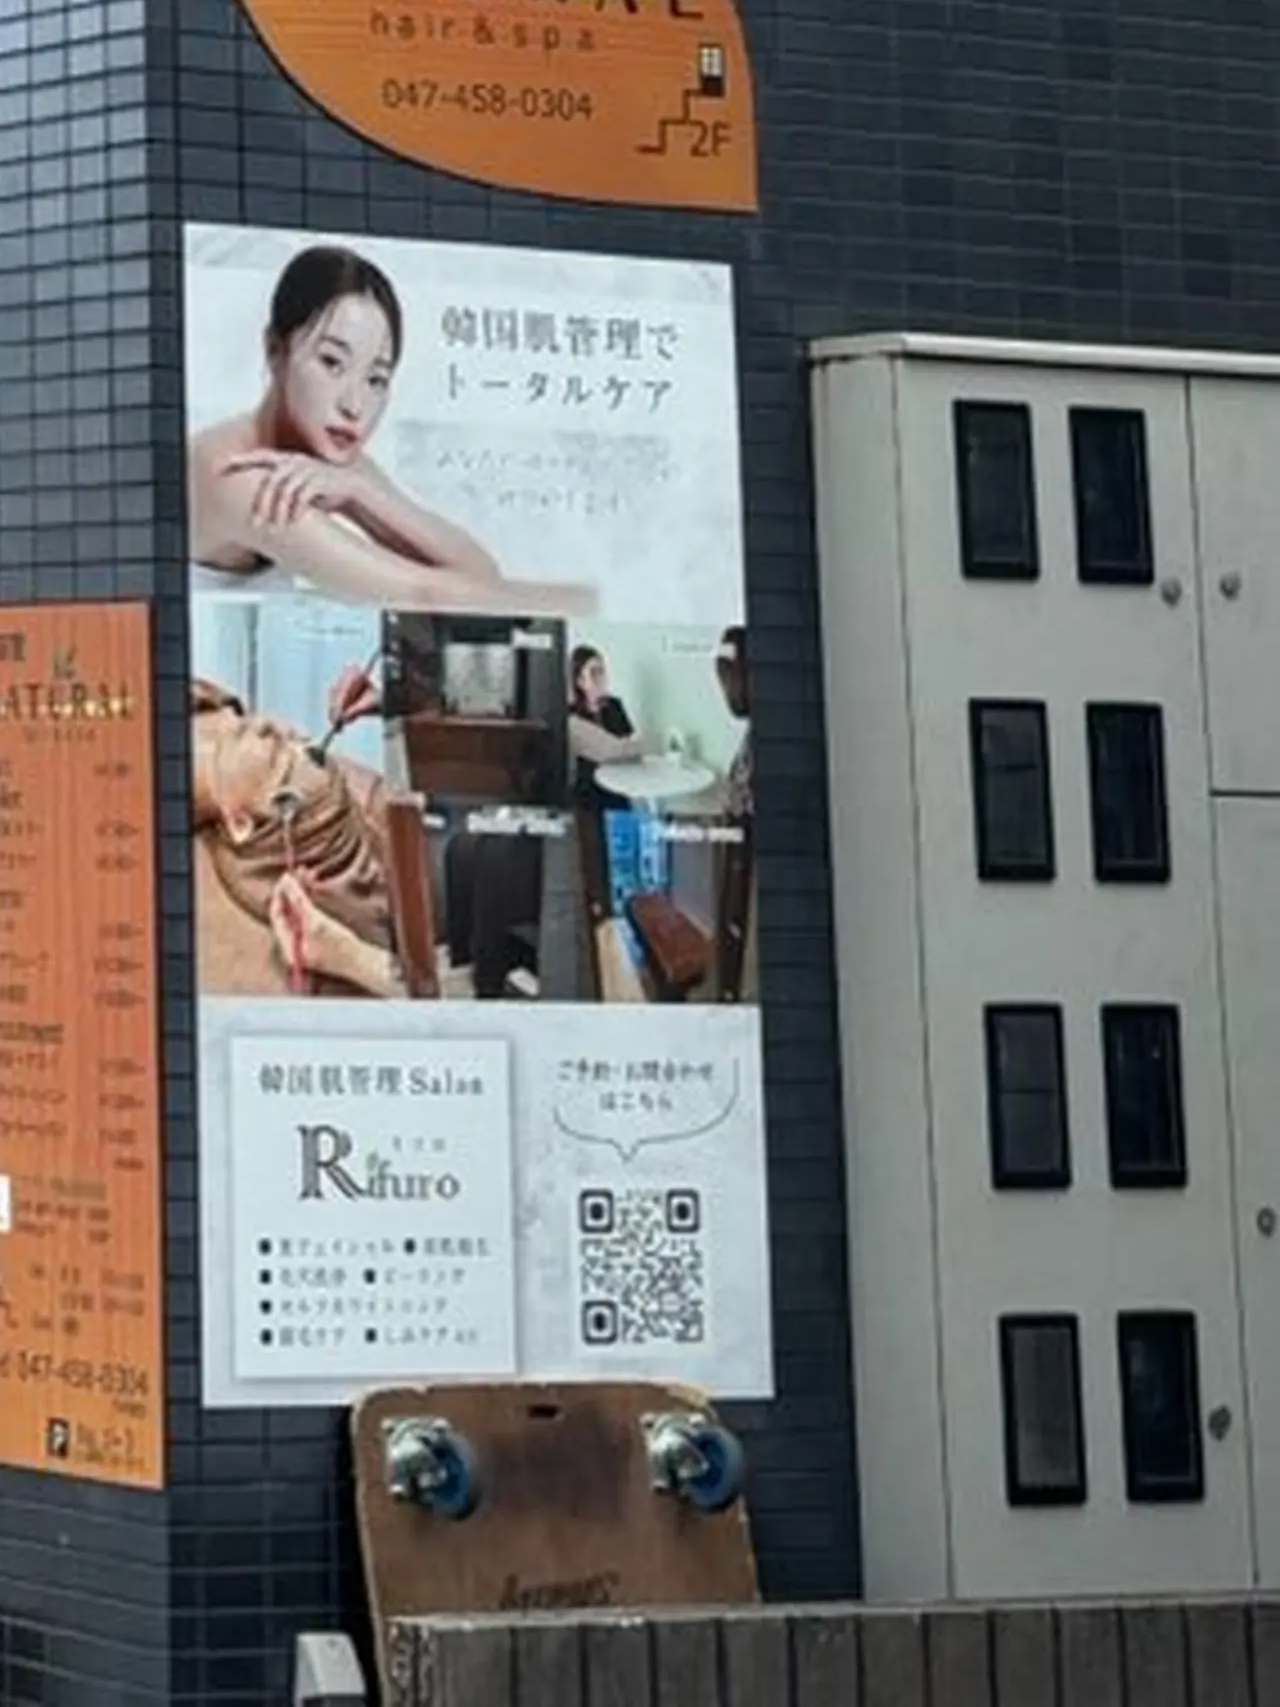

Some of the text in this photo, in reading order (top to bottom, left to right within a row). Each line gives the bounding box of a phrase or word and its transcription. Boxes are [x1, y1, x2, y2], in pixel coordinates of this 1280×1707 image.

[380, 77, 596, 123] 047-458-0304
[689, 121, 733, 158] 2F
[447, 361, 673, 415] トータルケア
[296, 1123, 462, 1202] Rifuro
